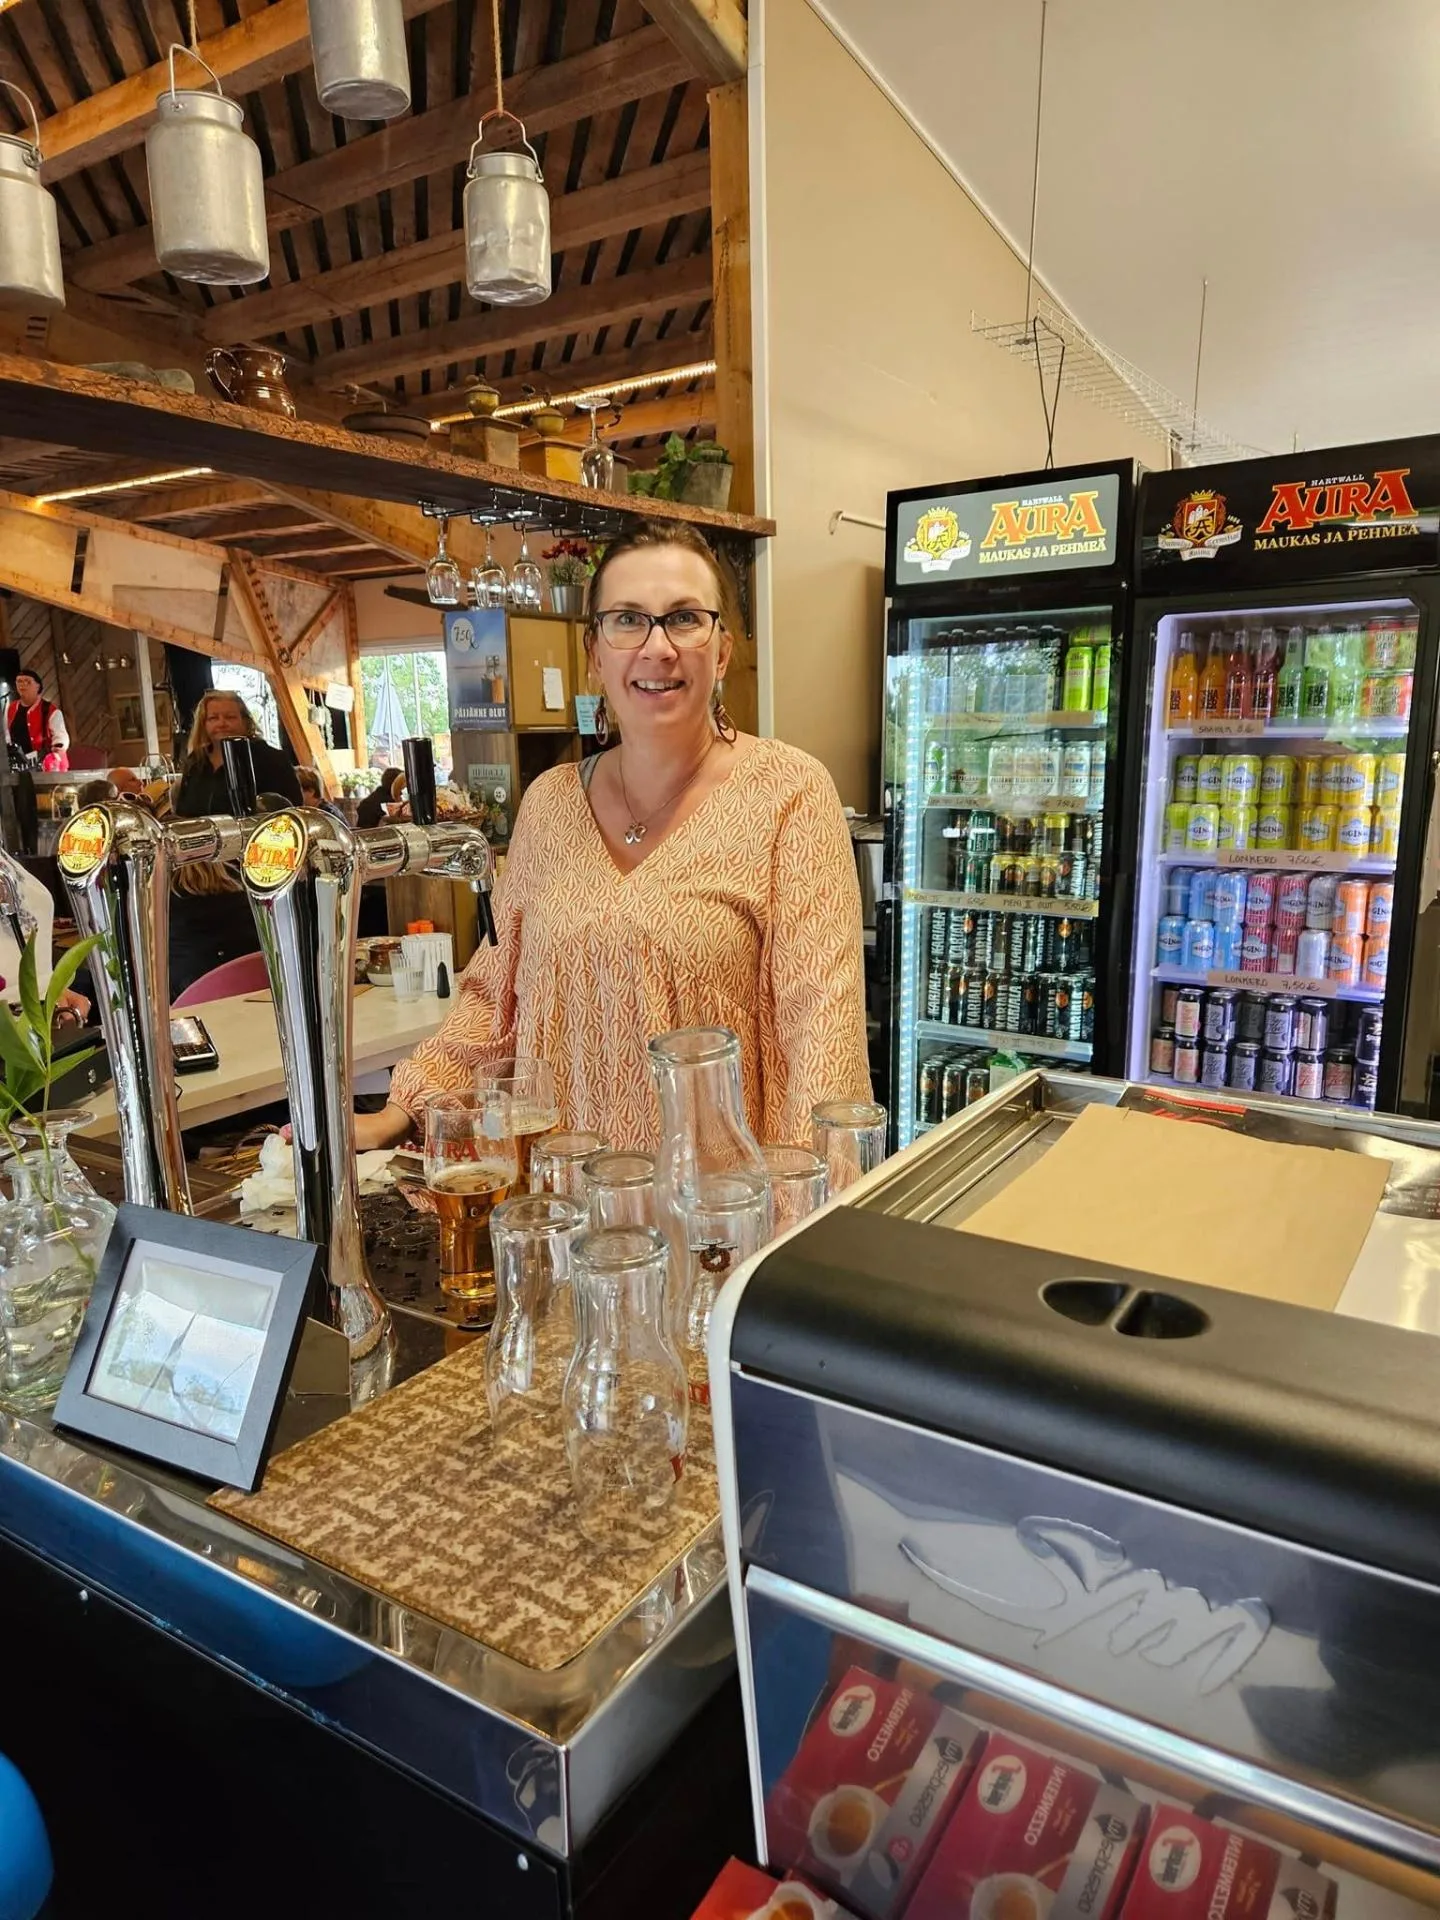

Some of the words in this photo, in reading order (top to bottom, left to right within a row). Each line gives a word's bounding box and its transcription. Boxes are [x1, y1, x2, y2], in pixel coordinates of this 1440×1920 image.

[1311, 473, 1365, 486] HARTWALL
[1022, 496, 1063, 506] HARTWALL
[1255, 468, 1419, 533] AURA
[980, 490, 1107, 548] AURA
[979, 547, 1031, 564] MAUKAS
[1033, 545, 1050, 558] JA
[1051, 537, 1107, 556] PEHMEÄ
[1254, 533, 1321, 550] MAUKAS
[1323, 532, 1344, 544] JA
[1348, 523, 1420, 541] PEHMEÄ
[489, 707, 506, 717] OLUT
[57, 832, 105, 861] AURA
[242, 842, 297, 871] AURA
[1010, 921, 1024, 967] KARJALA
[966, 981, 982, 1024] KARJALA
[1007, 986, 1021, 1031] KARJALA
